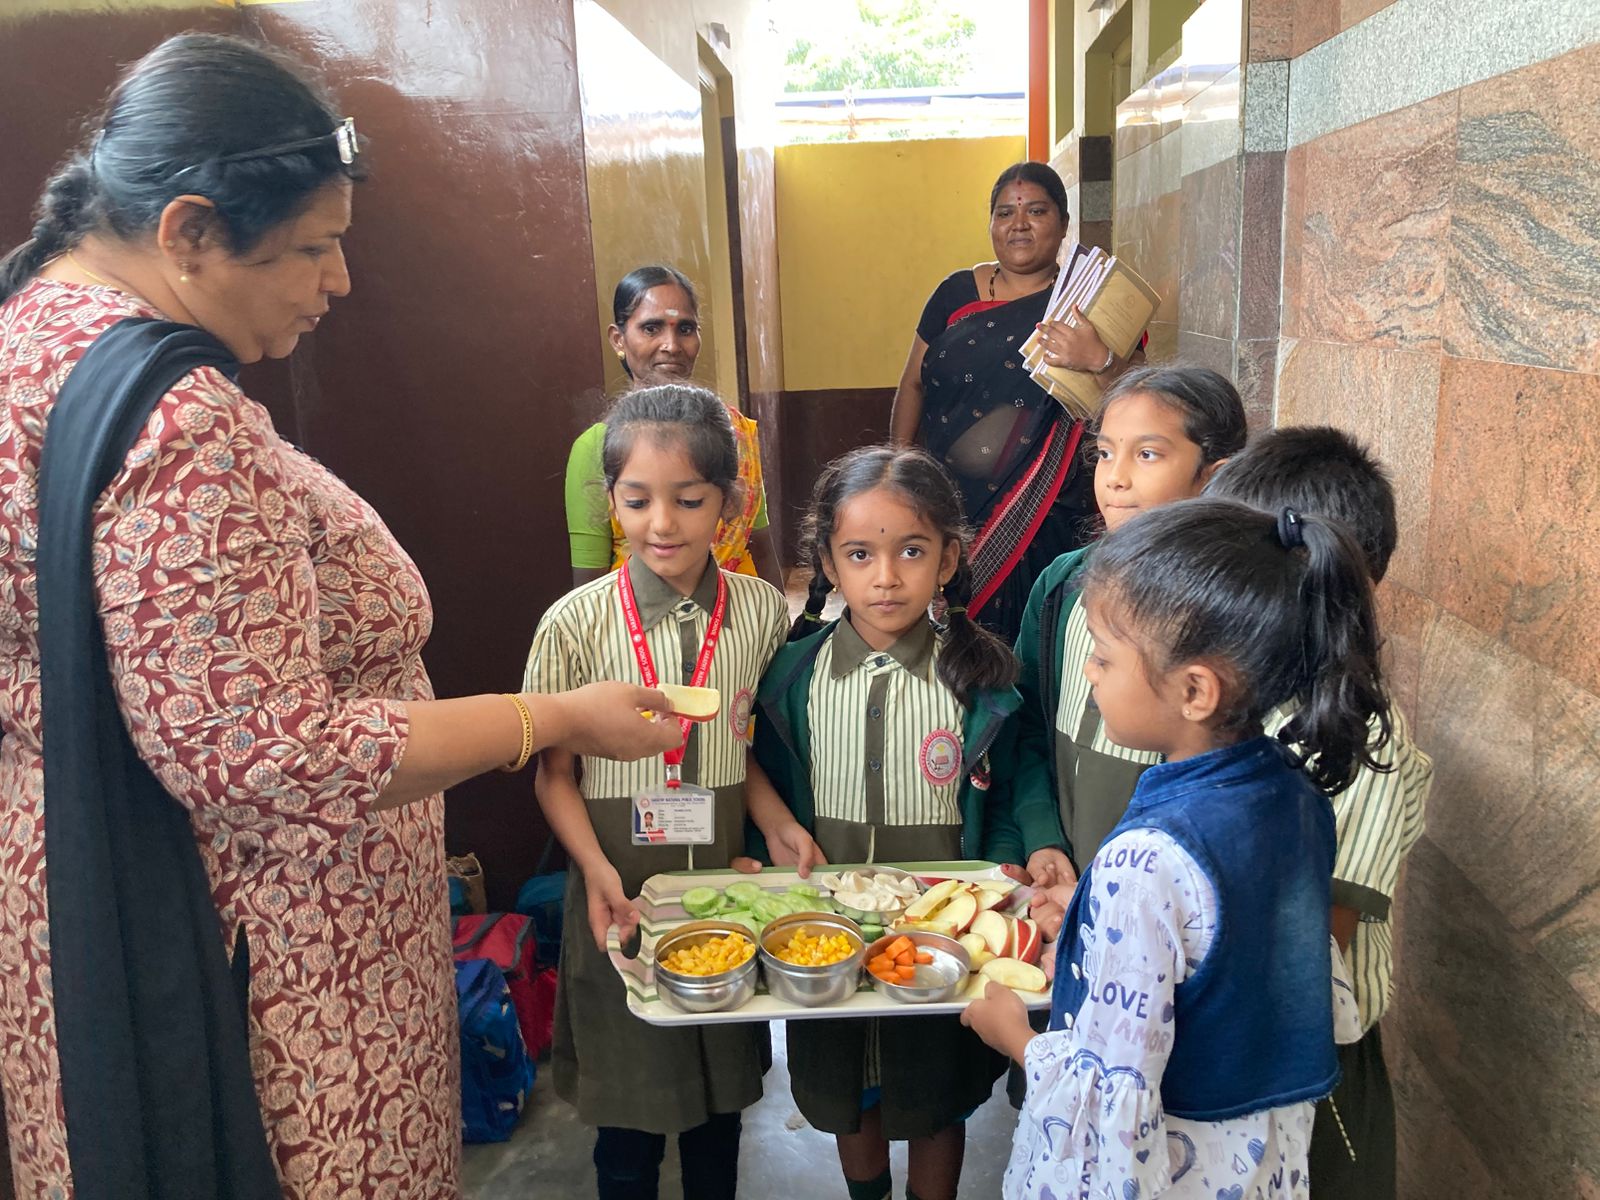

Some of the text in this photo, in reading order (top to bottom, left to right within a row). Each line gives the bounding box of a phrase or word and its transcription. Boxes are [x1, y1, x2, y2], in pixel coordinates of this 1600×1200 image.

[637, 645, 647, 665] SCHOOL
[1103, 848, 1158, 874] LOVE
[1090, 978, 1149, 1020] LOVE
[1114, 1018, 1171, 1054] AMOR
